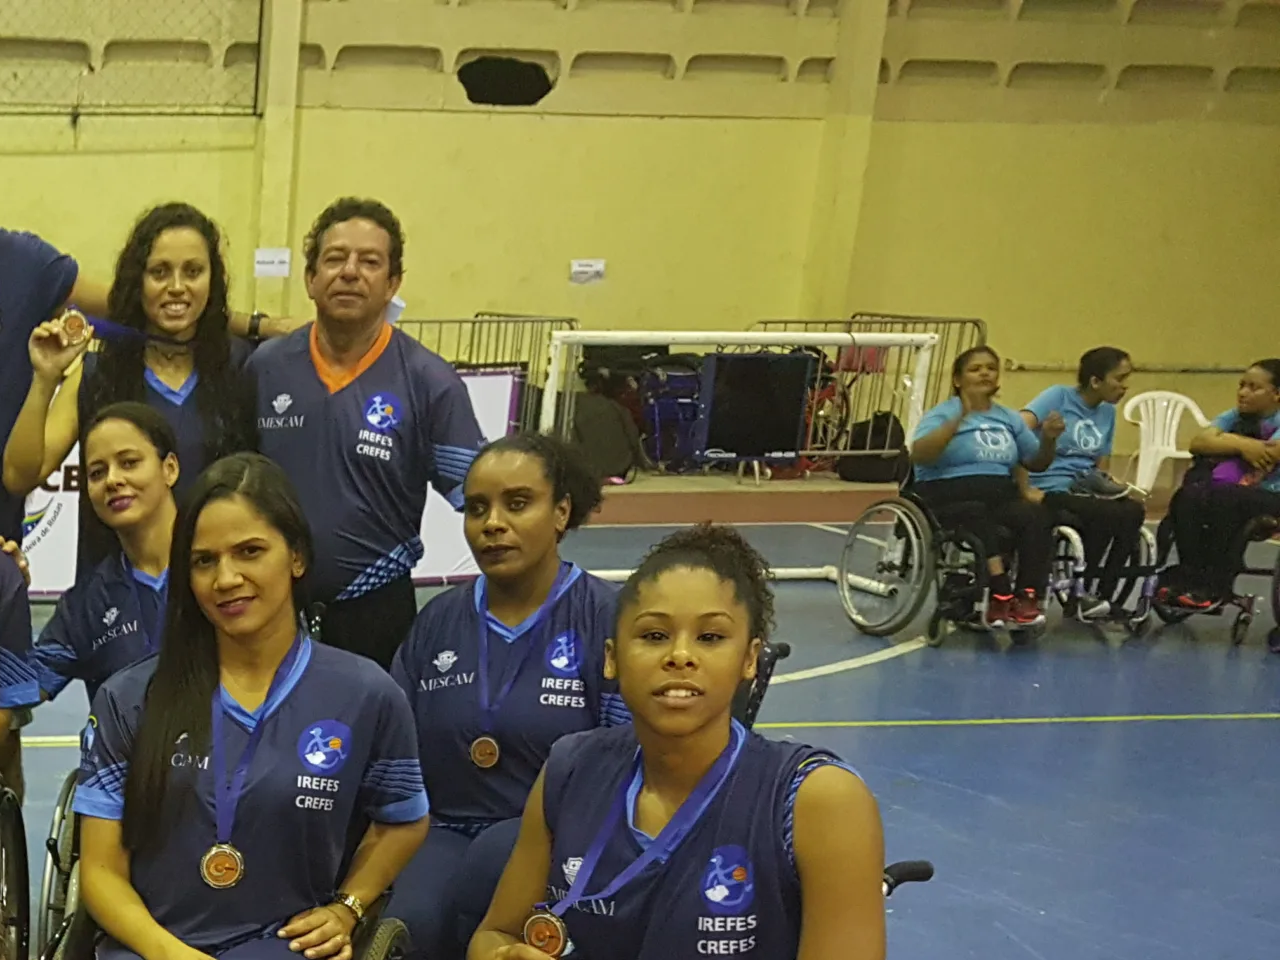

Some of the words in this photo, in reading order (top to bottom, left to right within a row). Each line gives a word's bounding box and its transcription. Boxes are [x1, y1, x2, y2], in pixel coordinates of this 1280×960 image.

[358, 429, 394, 447] IREFES
[356, 443, 392, 461] CREFES
[541, 677, 586, 691] IREFES
[539, 693, 586, 708] CREFES
[297, 775, 340, 792] IREFES
[295, 795, 334, 811] CREFES
[697, 915, 757, 932] IREFES
[697, 936, 756, 955] CREFES
